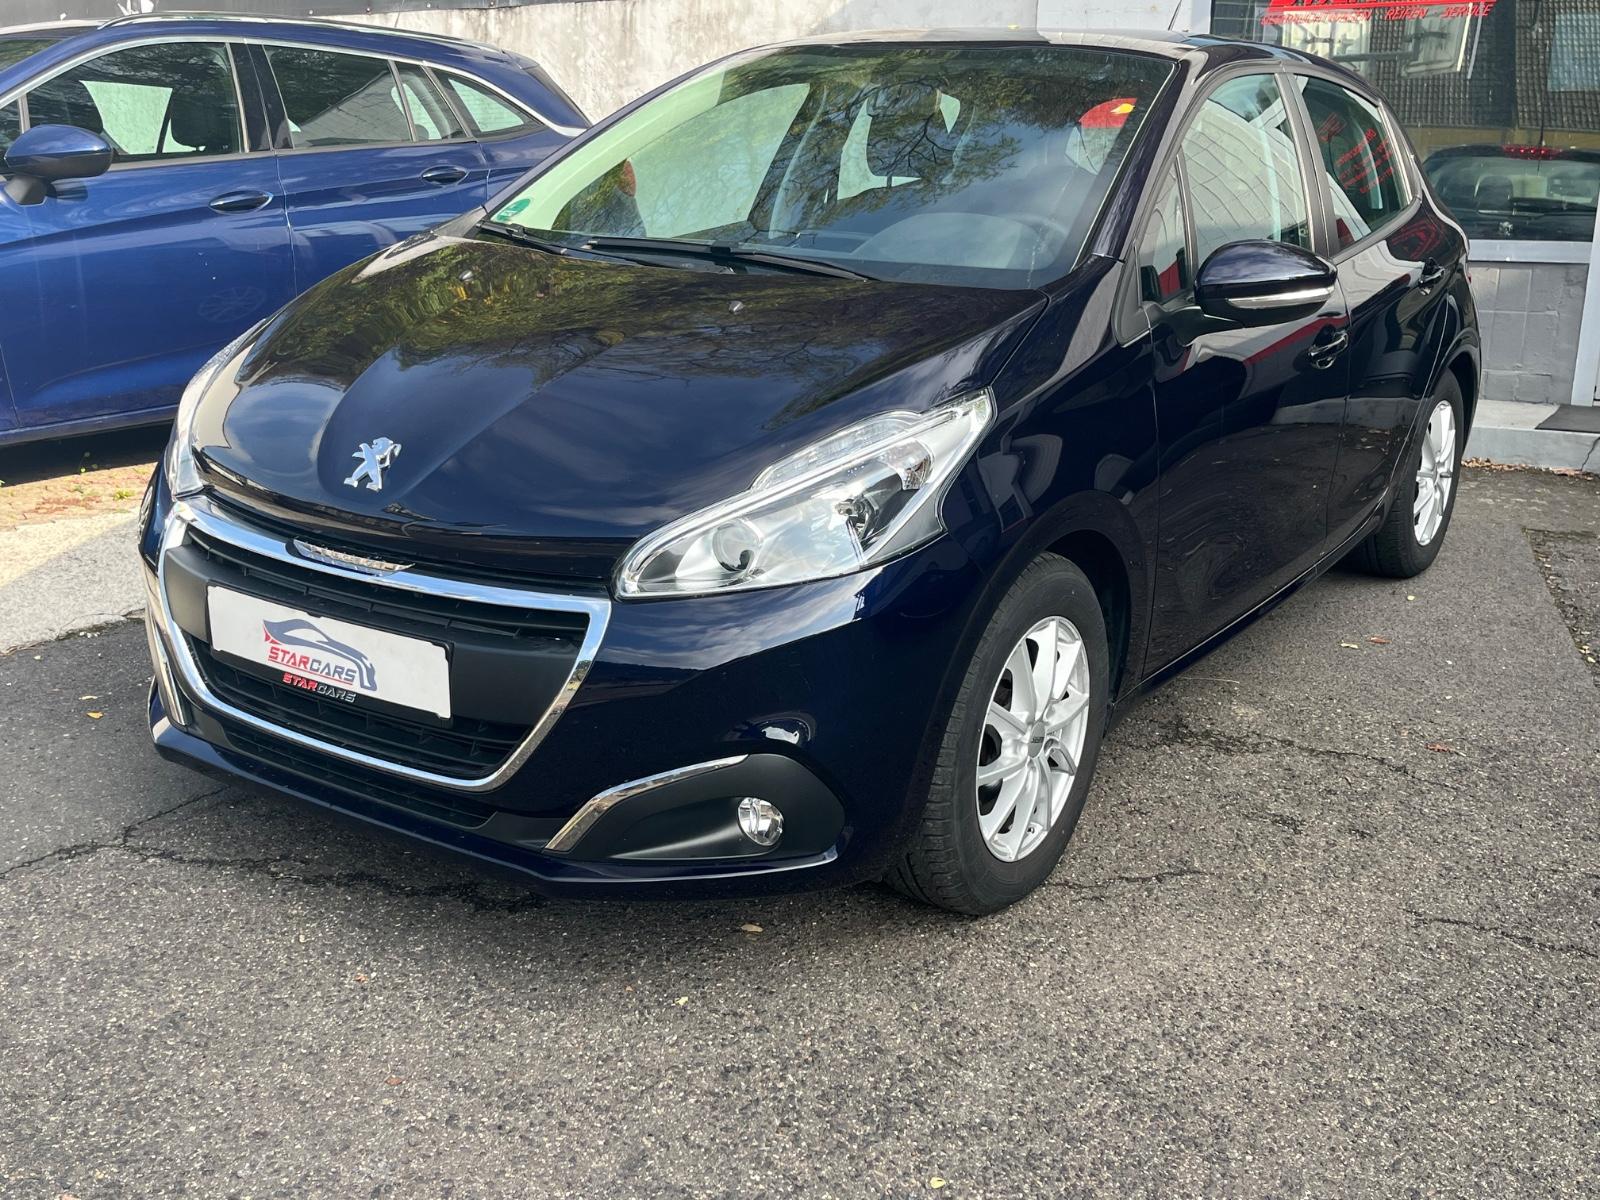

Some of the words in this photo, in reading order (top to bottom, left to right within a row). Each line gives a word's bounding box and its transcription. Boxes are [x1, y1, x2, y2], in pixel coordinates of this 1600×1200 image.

[1385, 7, 1428, 20] REIFEN
[269, 646, 356, 682] STARCARS
[283, 672, 356, 702] STARCARS
